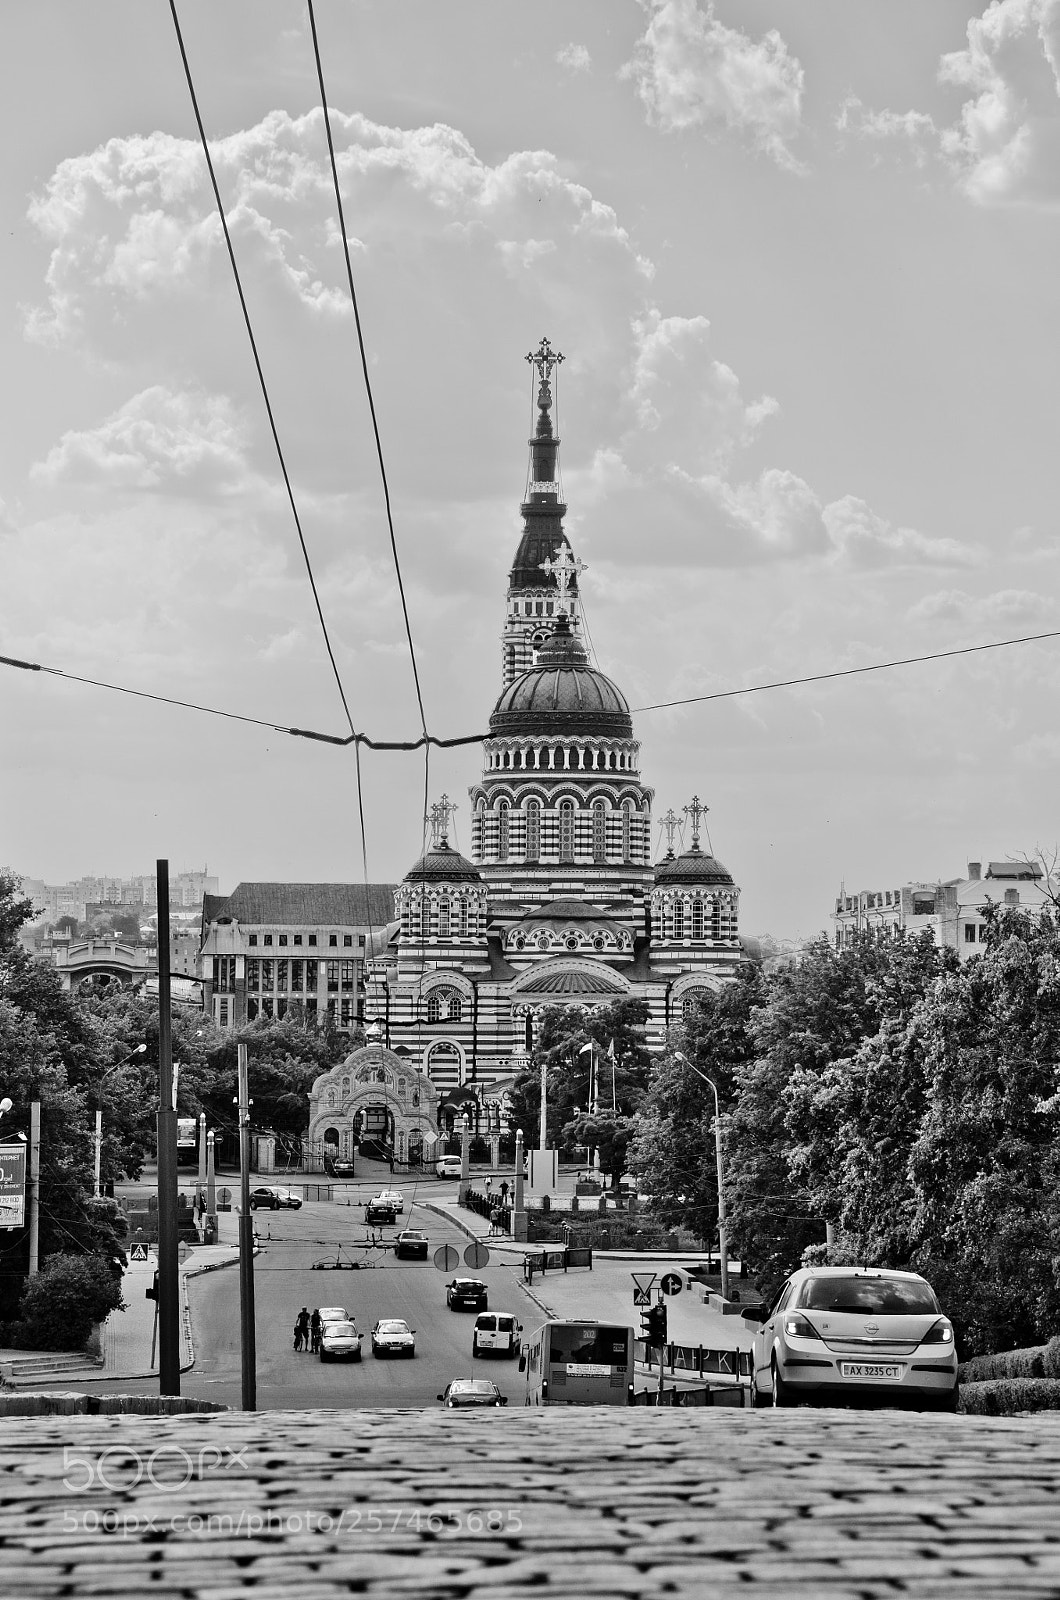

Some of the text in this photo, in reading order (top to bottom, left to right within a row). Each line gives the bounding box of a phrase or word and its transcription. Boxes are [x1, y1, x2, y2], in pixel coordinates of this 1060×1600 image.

[850, 1366, 898, 1376] AX 3235 CT
